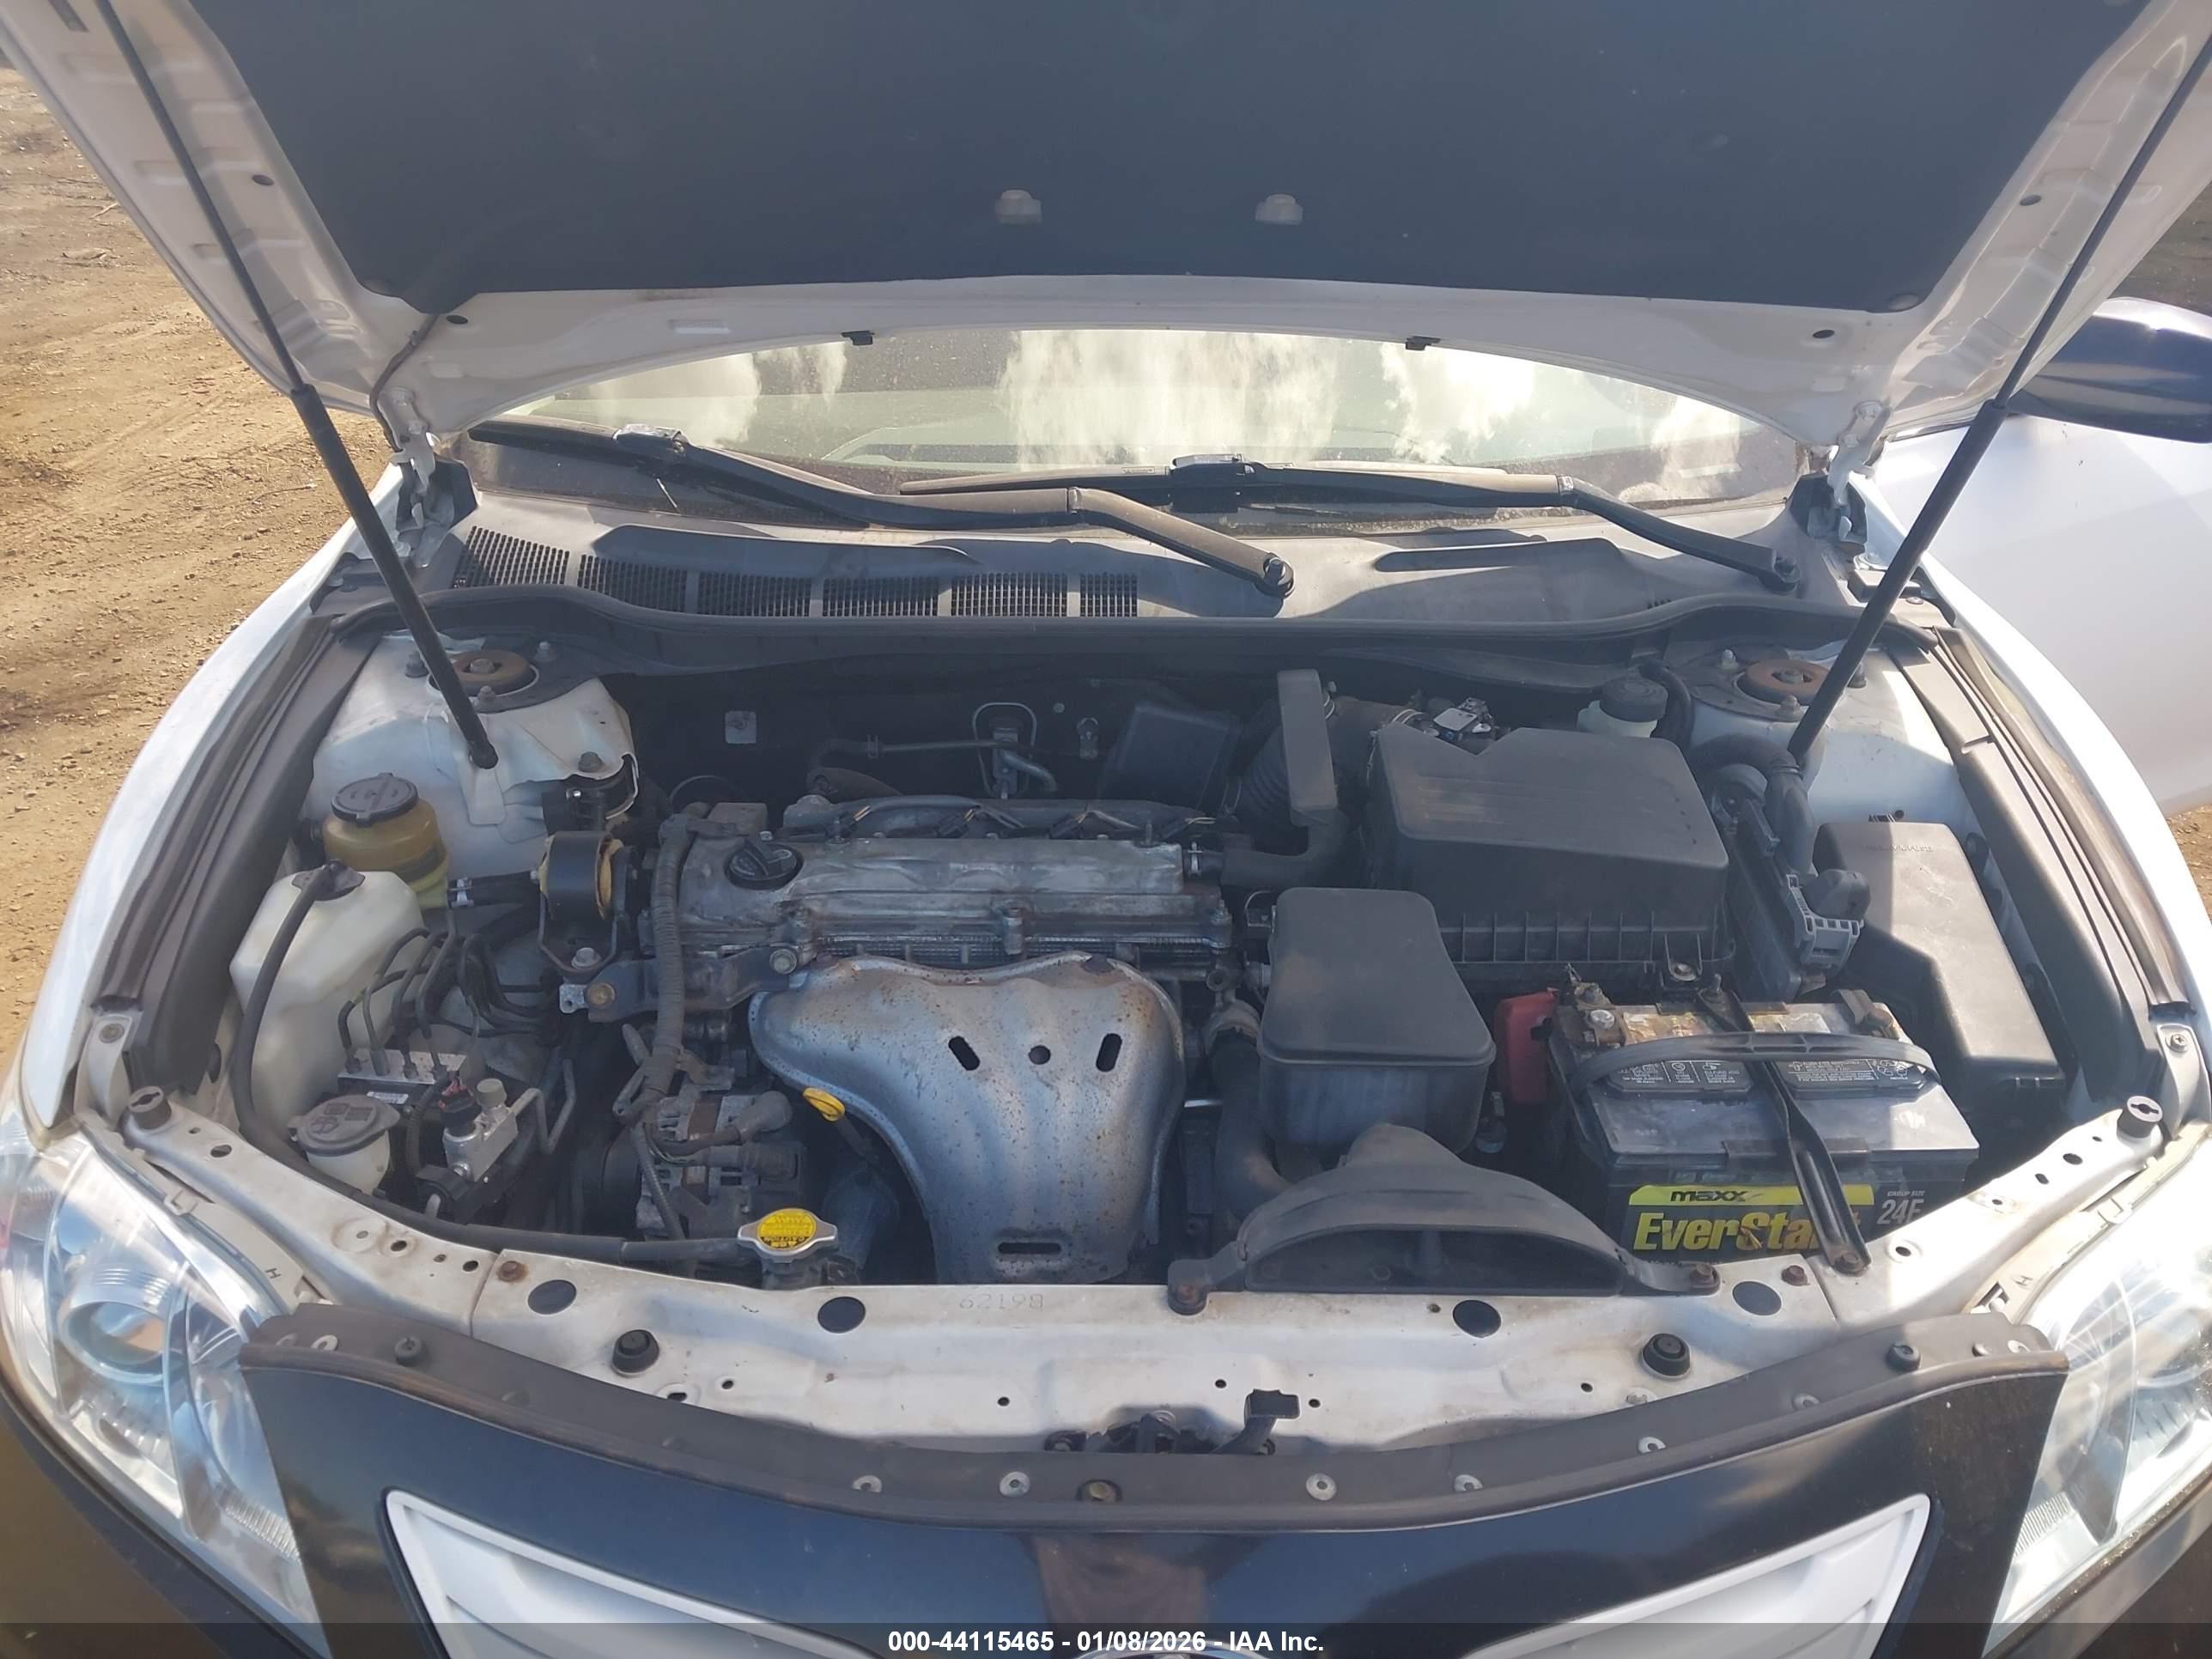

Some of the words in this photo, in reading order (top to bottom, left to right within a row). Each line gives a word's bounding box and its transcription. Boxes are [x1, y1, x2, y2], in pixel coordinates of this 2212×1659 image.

[1671, 1190, 1748, 1203] maxx
[1633, 1212, 1861, 1251] EverSta
[959, 1292, 1044, 1310] 62198
